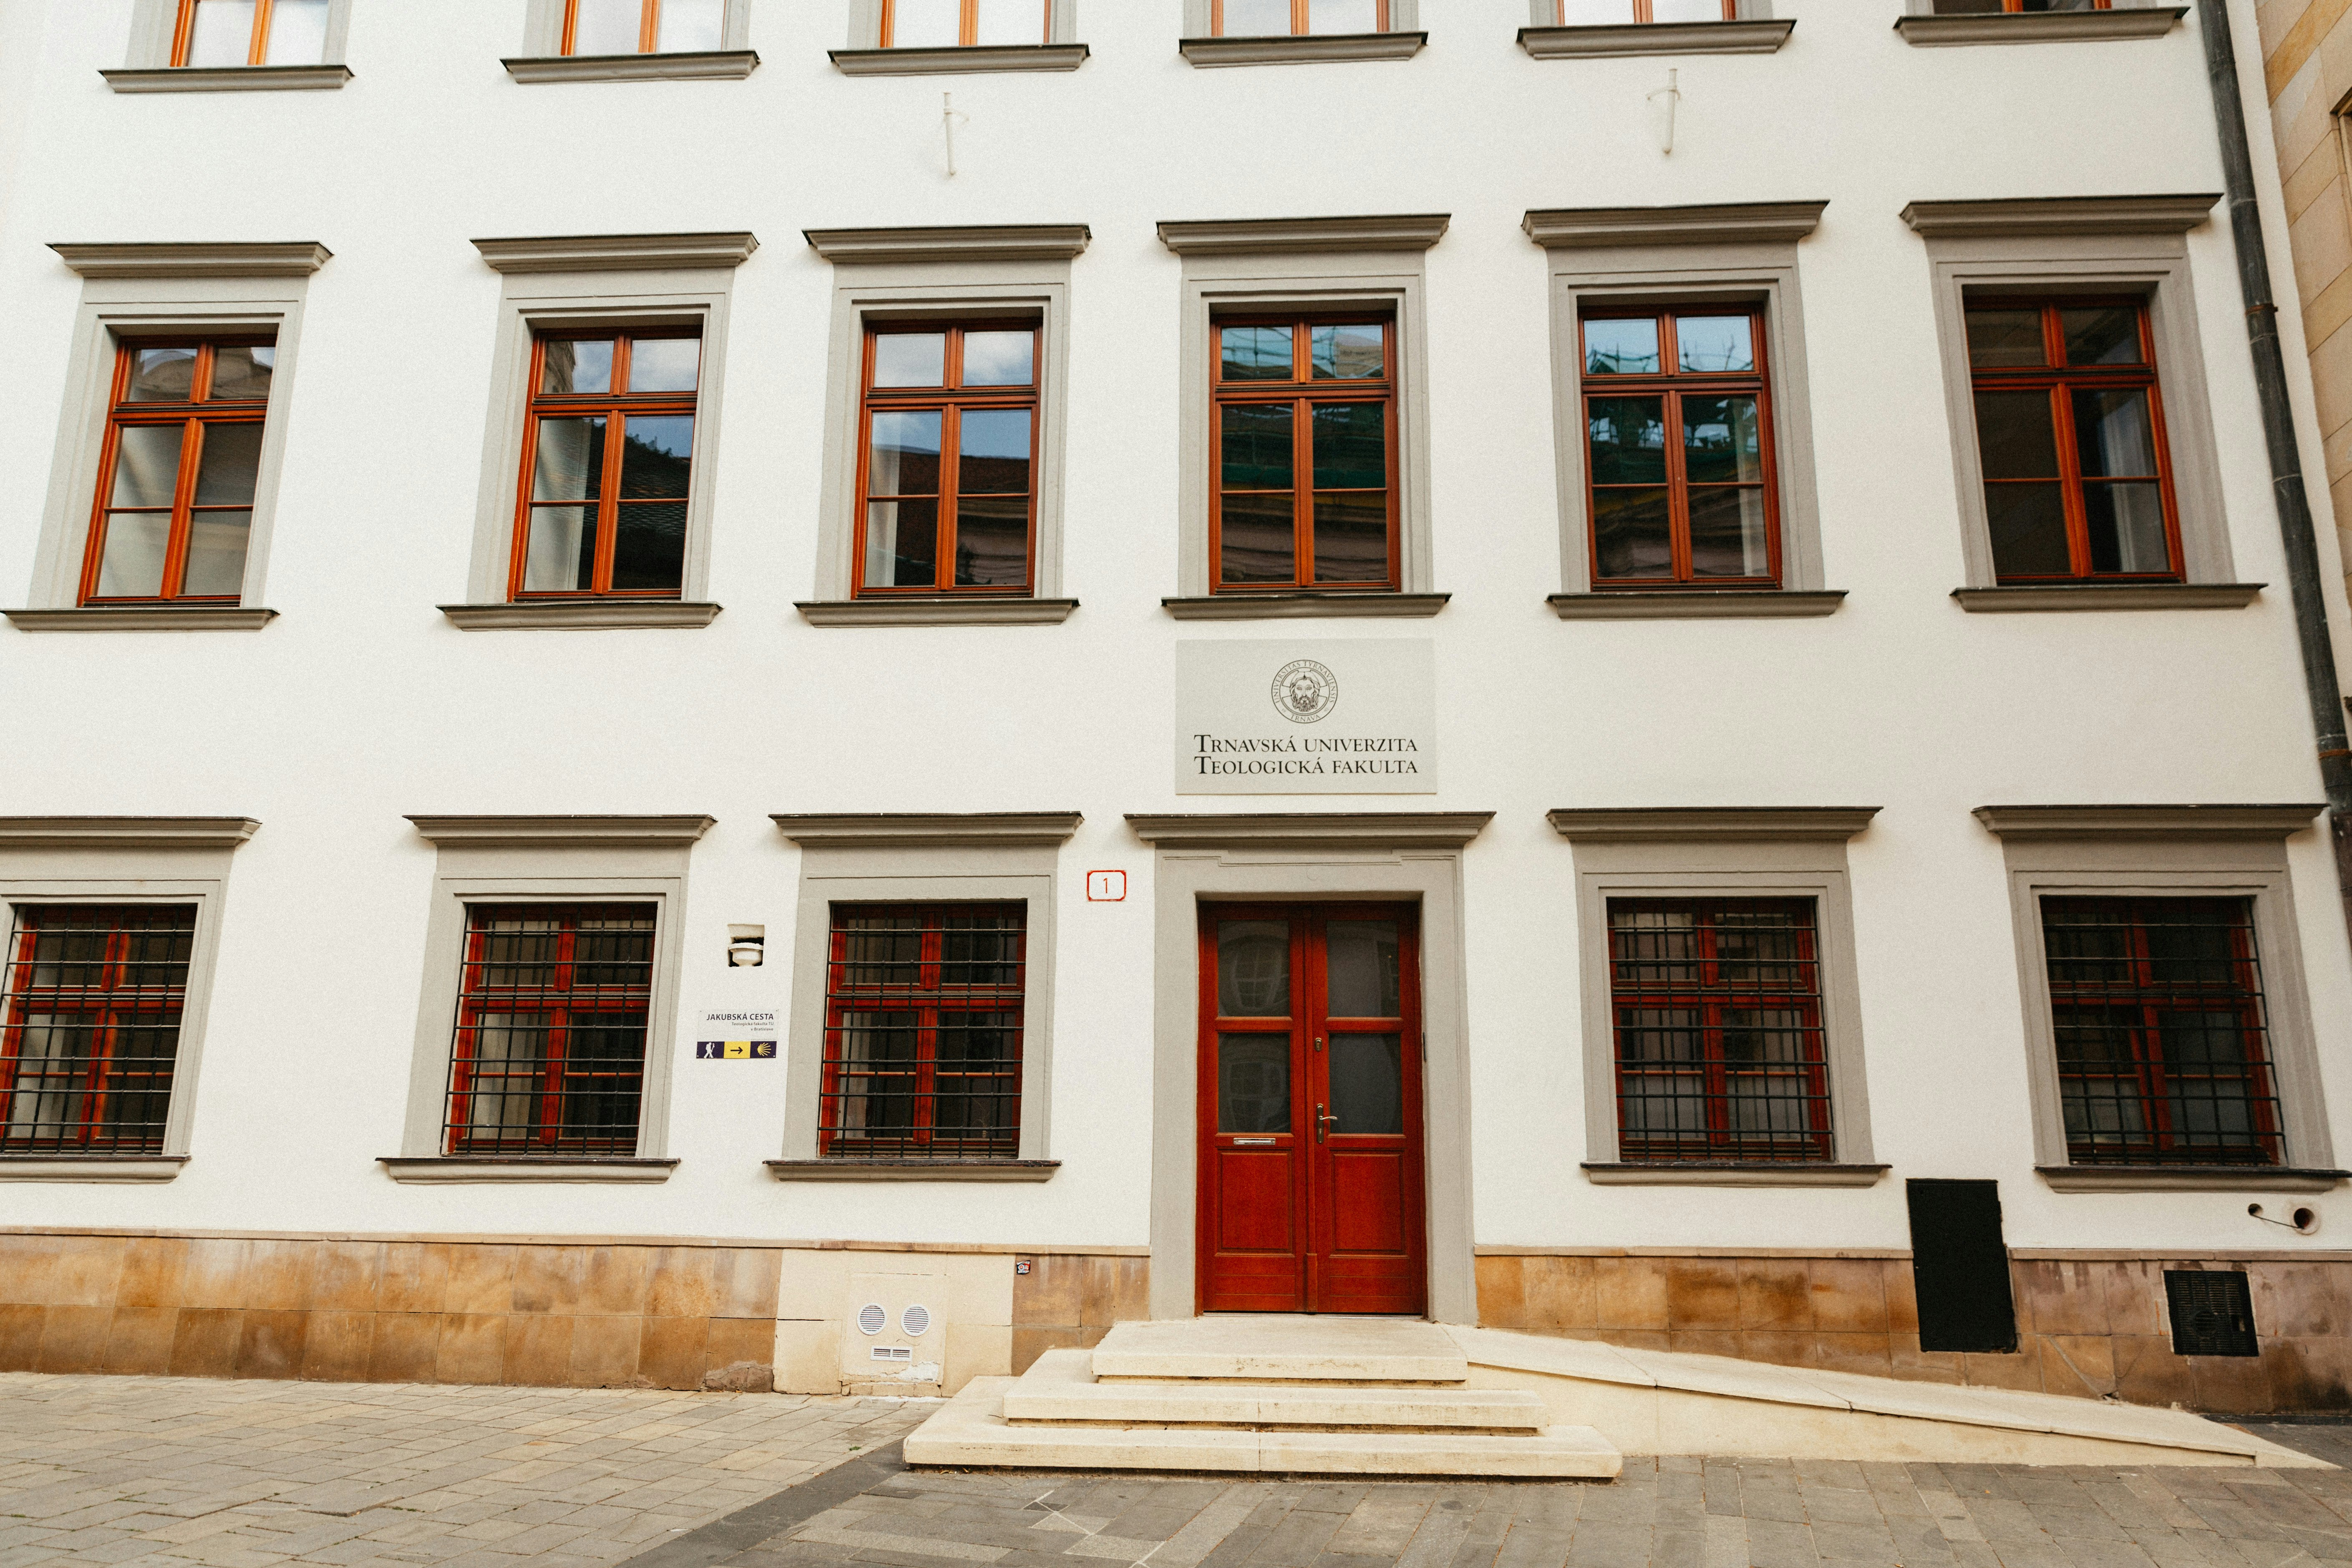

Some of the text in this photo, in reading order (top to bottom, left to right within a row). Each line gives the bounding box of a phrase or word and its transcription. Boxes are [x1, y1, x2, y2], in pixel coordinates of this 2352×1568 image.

[1273, 661, 1336, 703] UNIVERSITAS TYRNAVIENSIS
[1194, 735, 1419, 752] TRNAVSKÁ UNIVERZITA
[1194, 756, 1418, 774] TEOLOGICKÁ FAKULTA
[1103, 878, 1108, 893] 1
